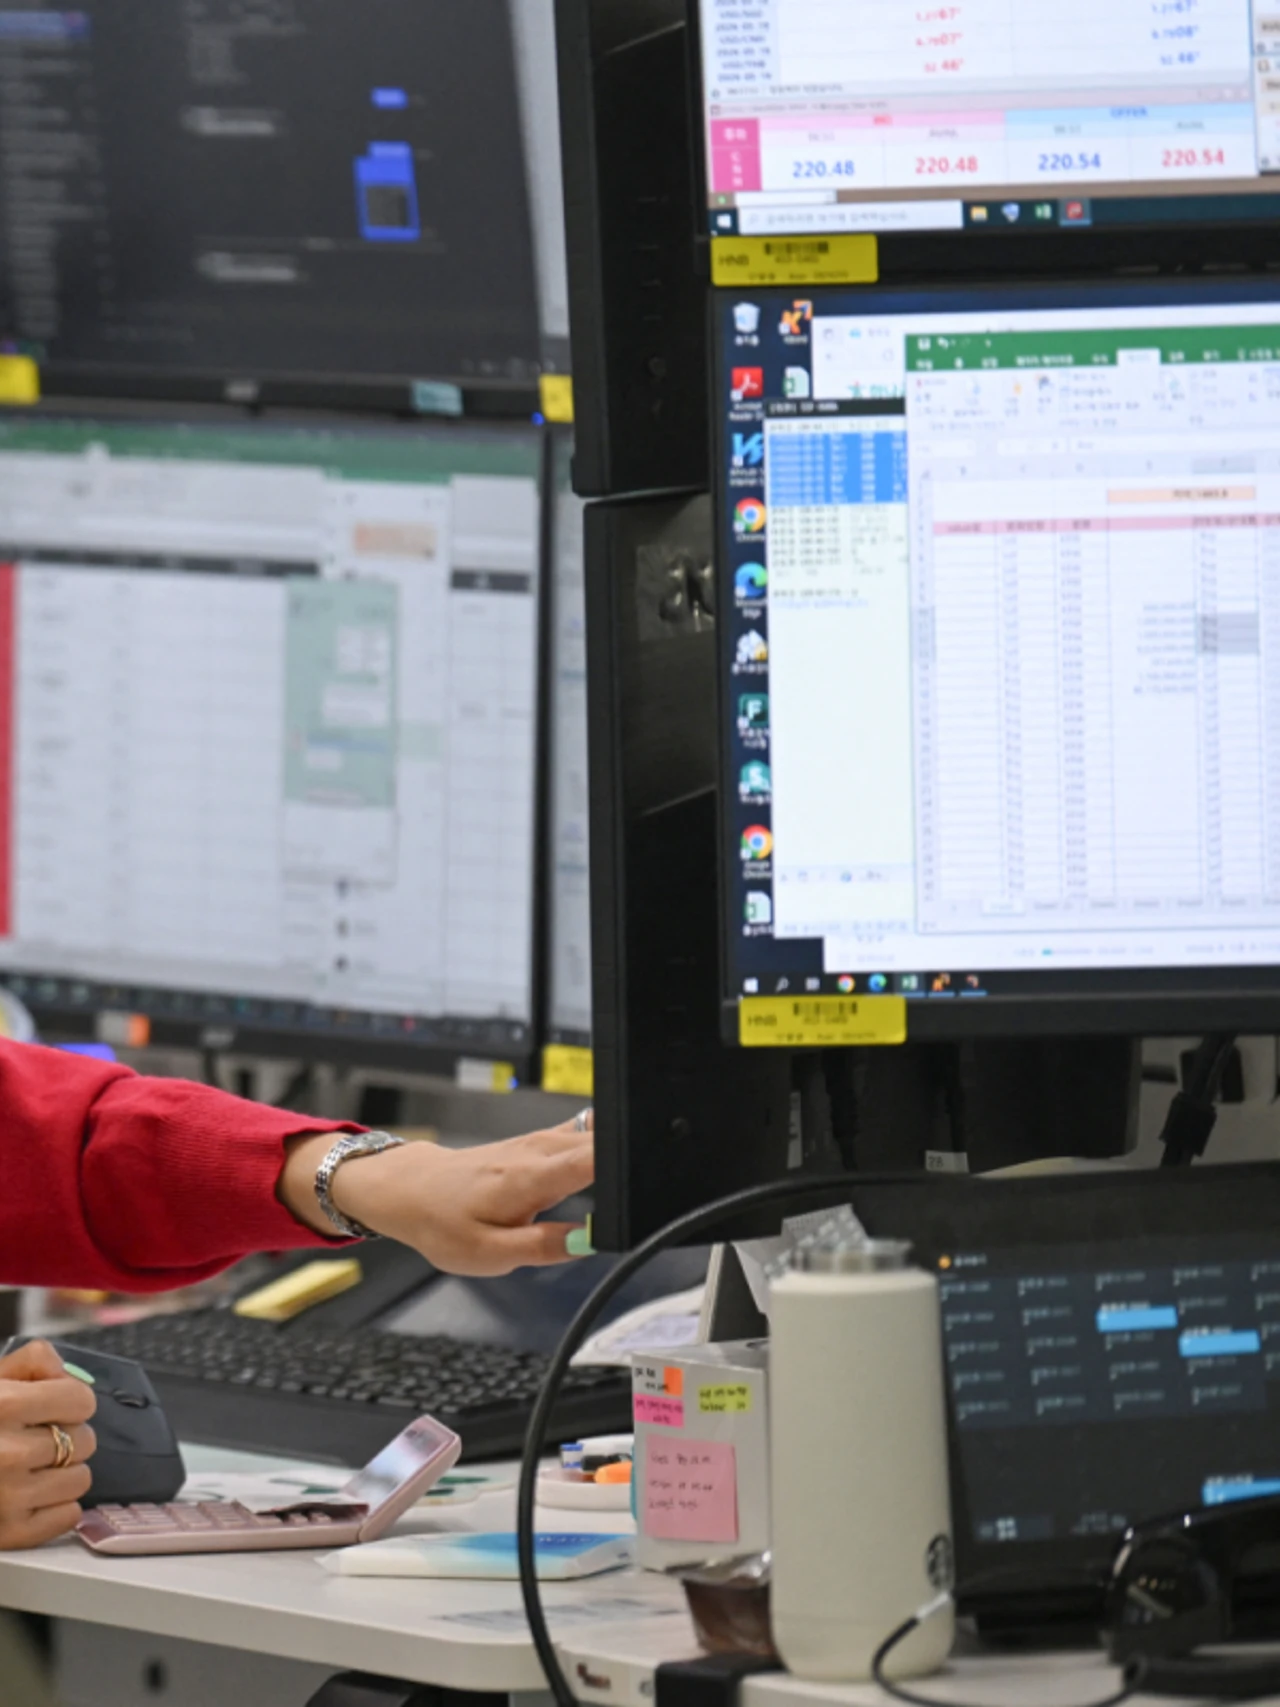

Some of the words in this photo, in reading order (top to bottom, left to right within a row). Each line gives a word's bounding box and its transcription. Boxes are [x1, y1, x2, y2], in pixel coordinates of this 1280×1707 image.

[914, 156, 979, 175] 220.48
[1038, 153, 1102, 172] 220.54
[1162, 149, 1225, 168] 220.54
[792, 160, 855, 179] 220.48
